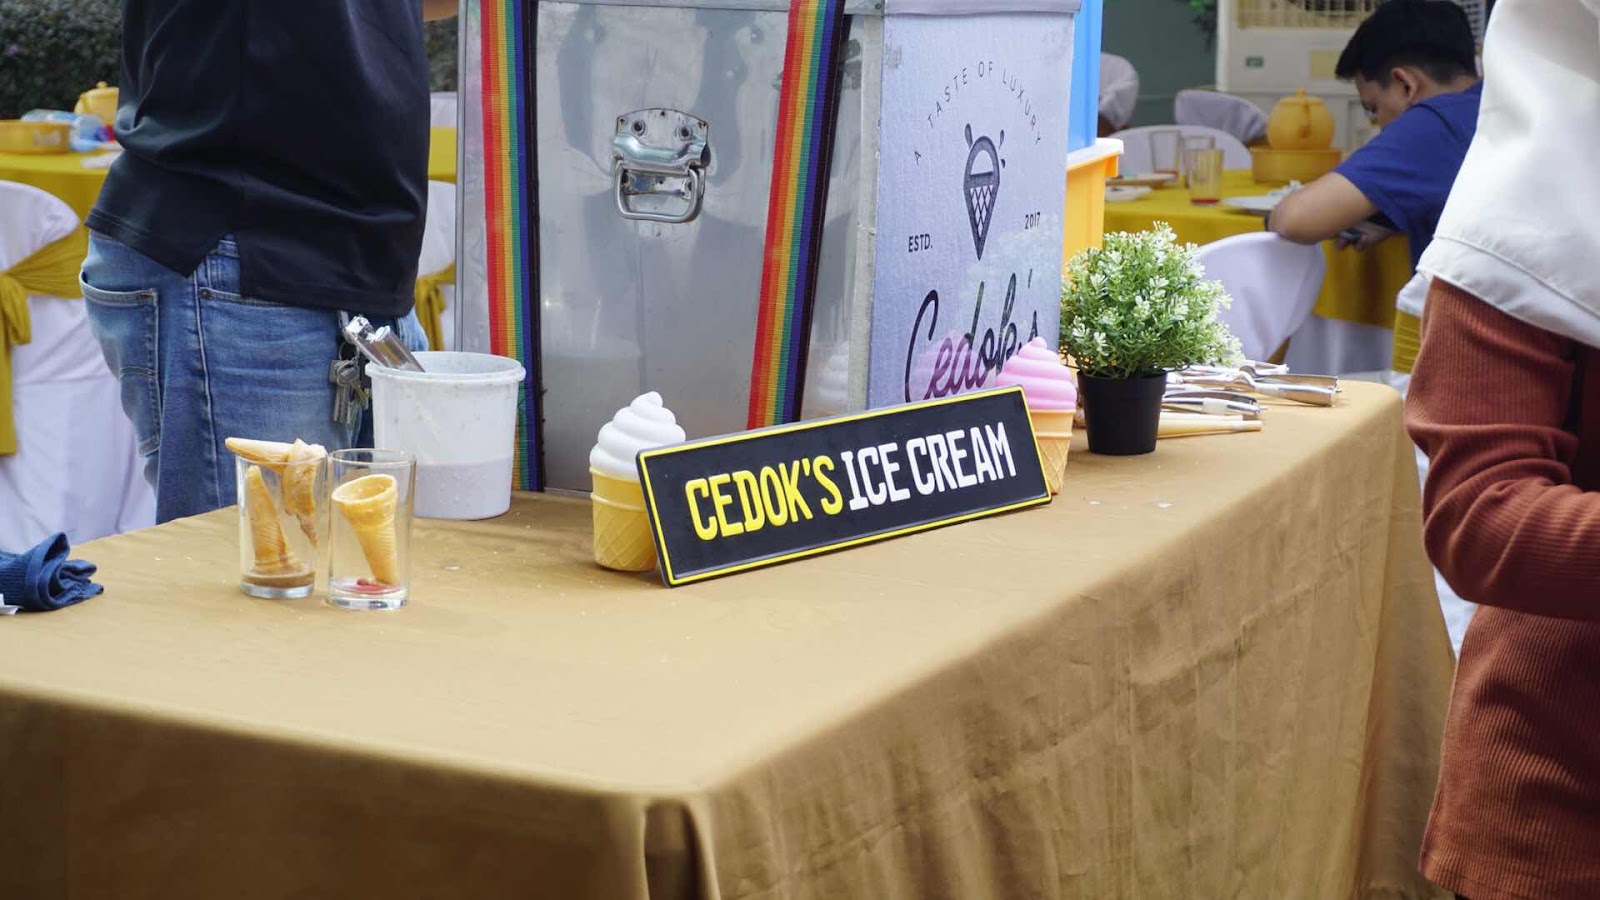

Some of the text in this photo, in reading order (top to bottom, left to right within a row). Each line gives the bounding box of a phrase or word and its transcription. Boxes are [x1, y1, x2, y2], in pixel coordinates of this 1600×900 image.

[914, 60, 1042, 166] A TASTE OF LUXURY
[908, 211, 1041, 253] ESTD. 2017
[684, 421, 1017, 541] CEDOK'S ICE CREAM
